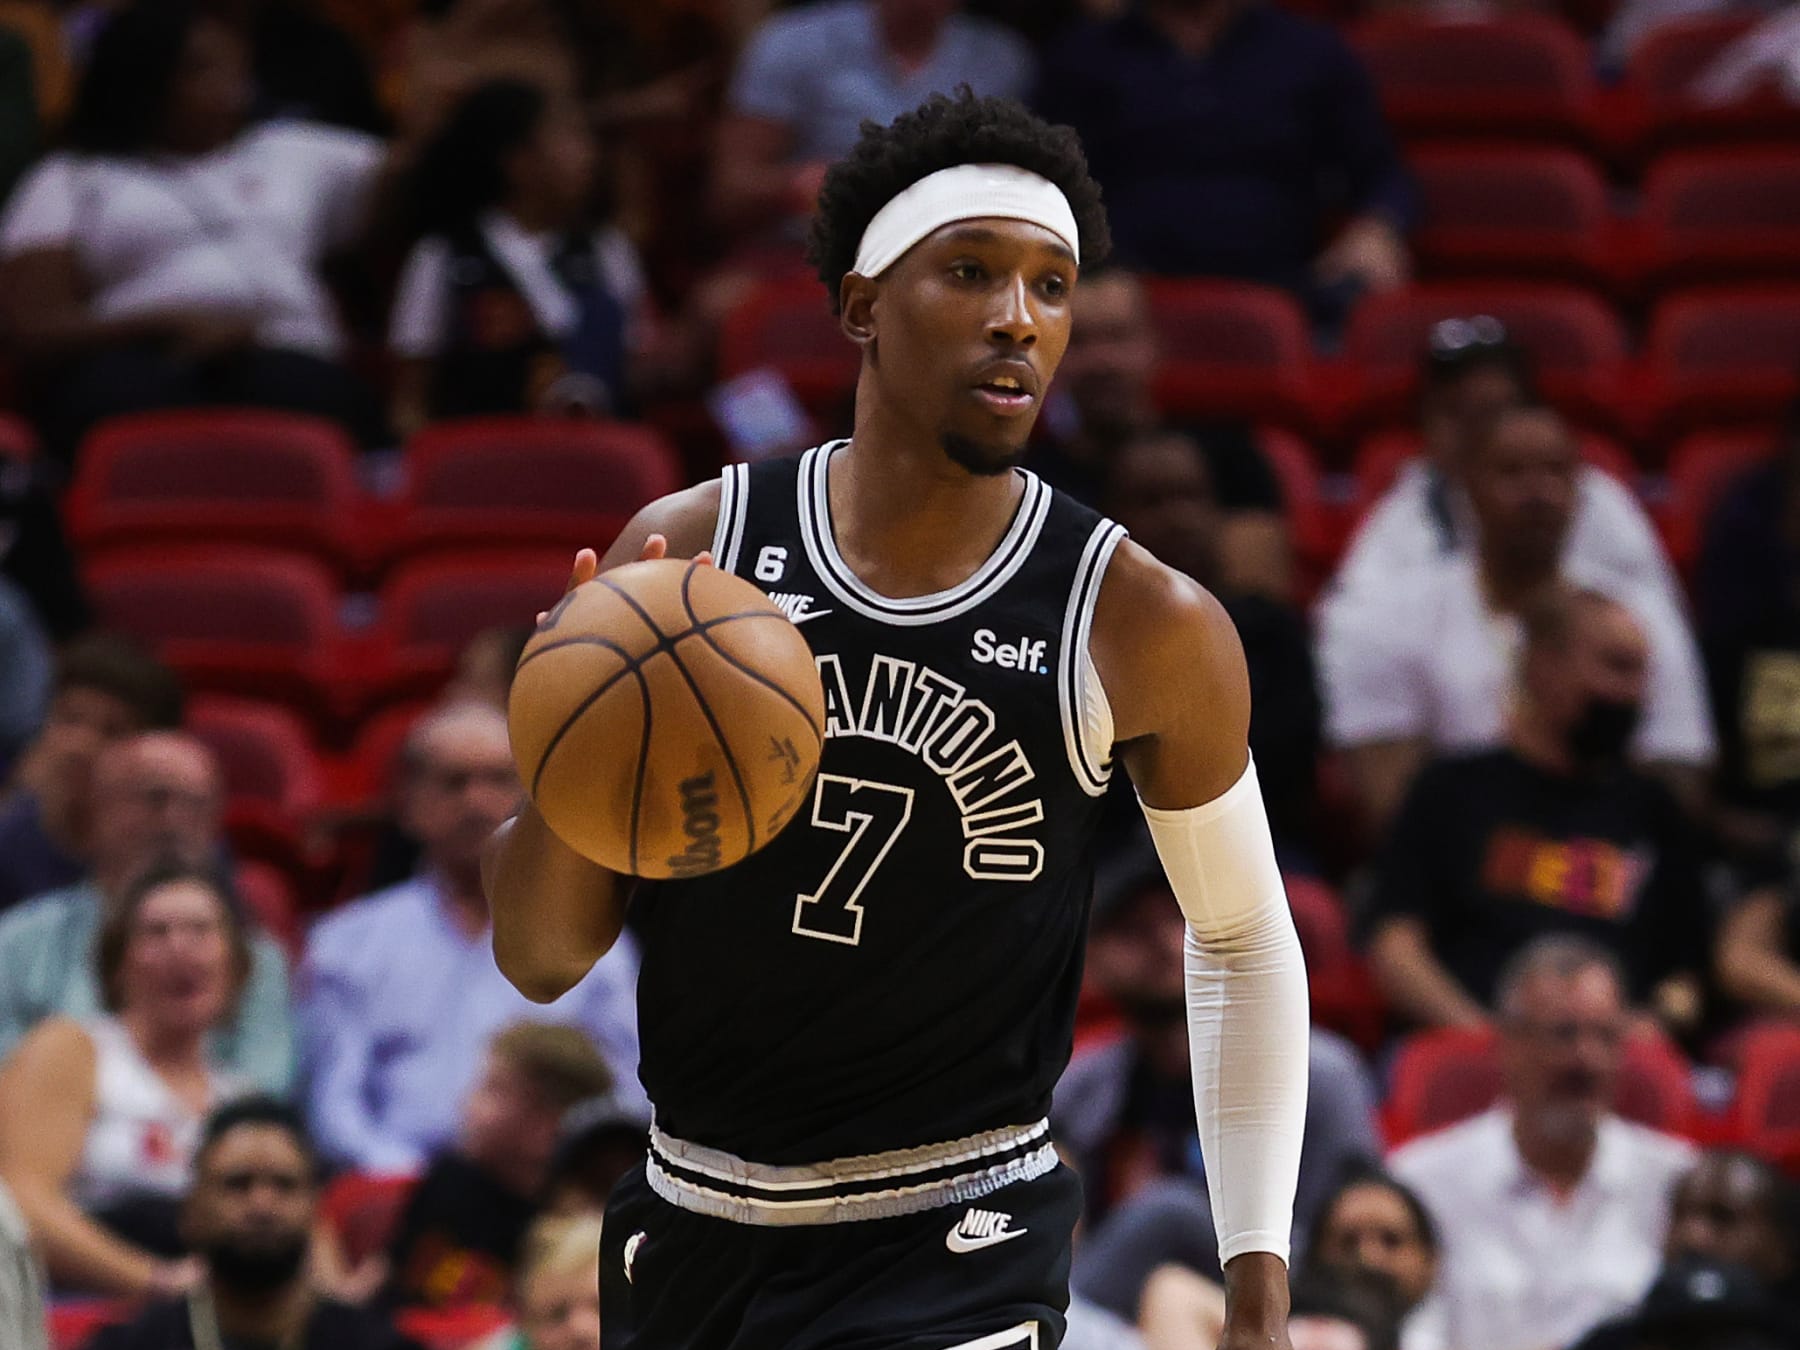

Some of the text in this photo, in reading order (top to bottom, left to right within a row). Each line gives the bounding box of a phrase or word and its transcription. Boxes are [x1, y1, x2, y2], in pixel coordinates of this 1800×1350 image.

[754, 545, 788, 582] 6
[816, 653, 1044, 881] ANTONIO
[792, 772, 915, 946] 7
